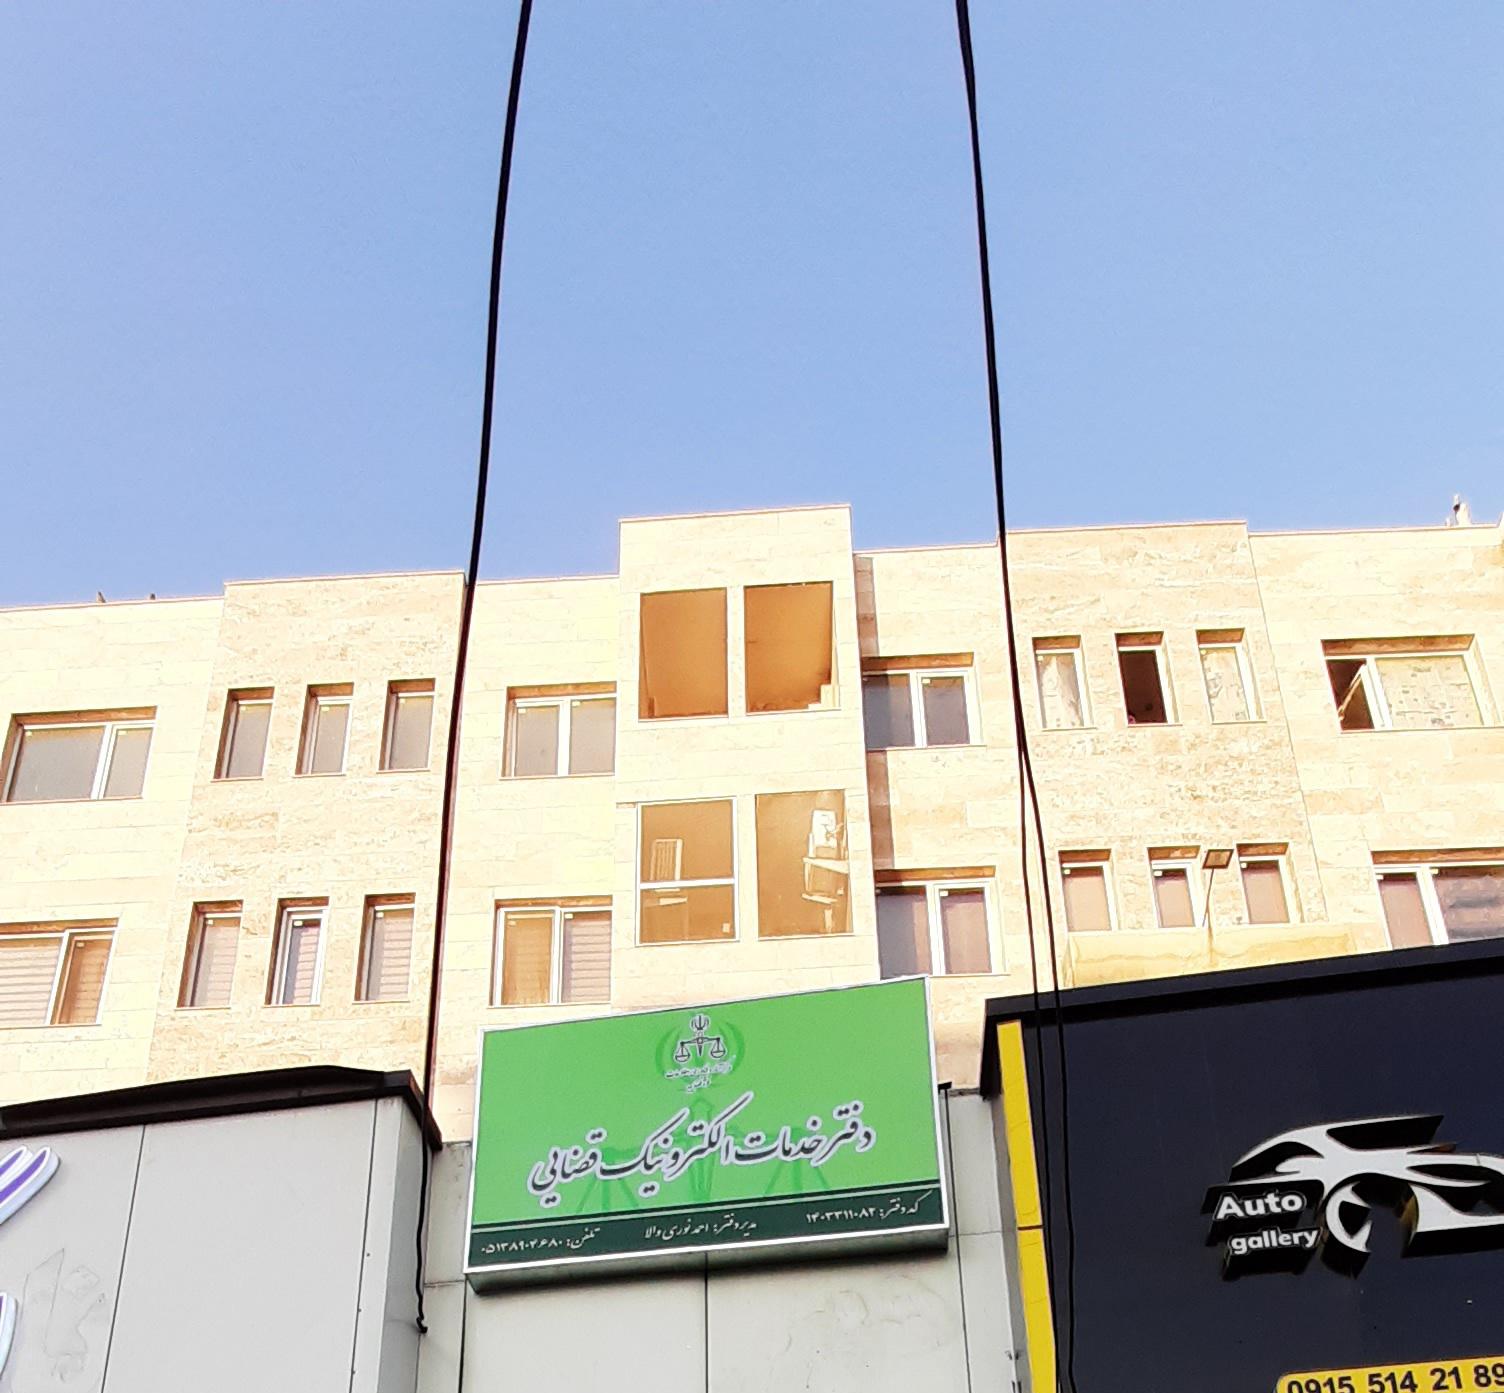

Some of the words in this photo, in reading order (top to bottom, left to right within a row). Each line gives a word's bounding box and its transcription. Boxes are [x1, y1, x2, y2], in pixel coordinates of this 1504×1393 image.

[599, 1094, 751, 1194] الکترونیک
[734, 1118, 823, 1162] خدمات
[815, 1102, 873, 1164] دفتر
[906, 1189, 933, 1214] کد
[1216, 1192, 1304, 1220] Auto
[1230, 1229, 1320, 1255] gallery
[1430, 1365, 1463, 1391] 21
[1474, 1361, 1504, 1389] 89
